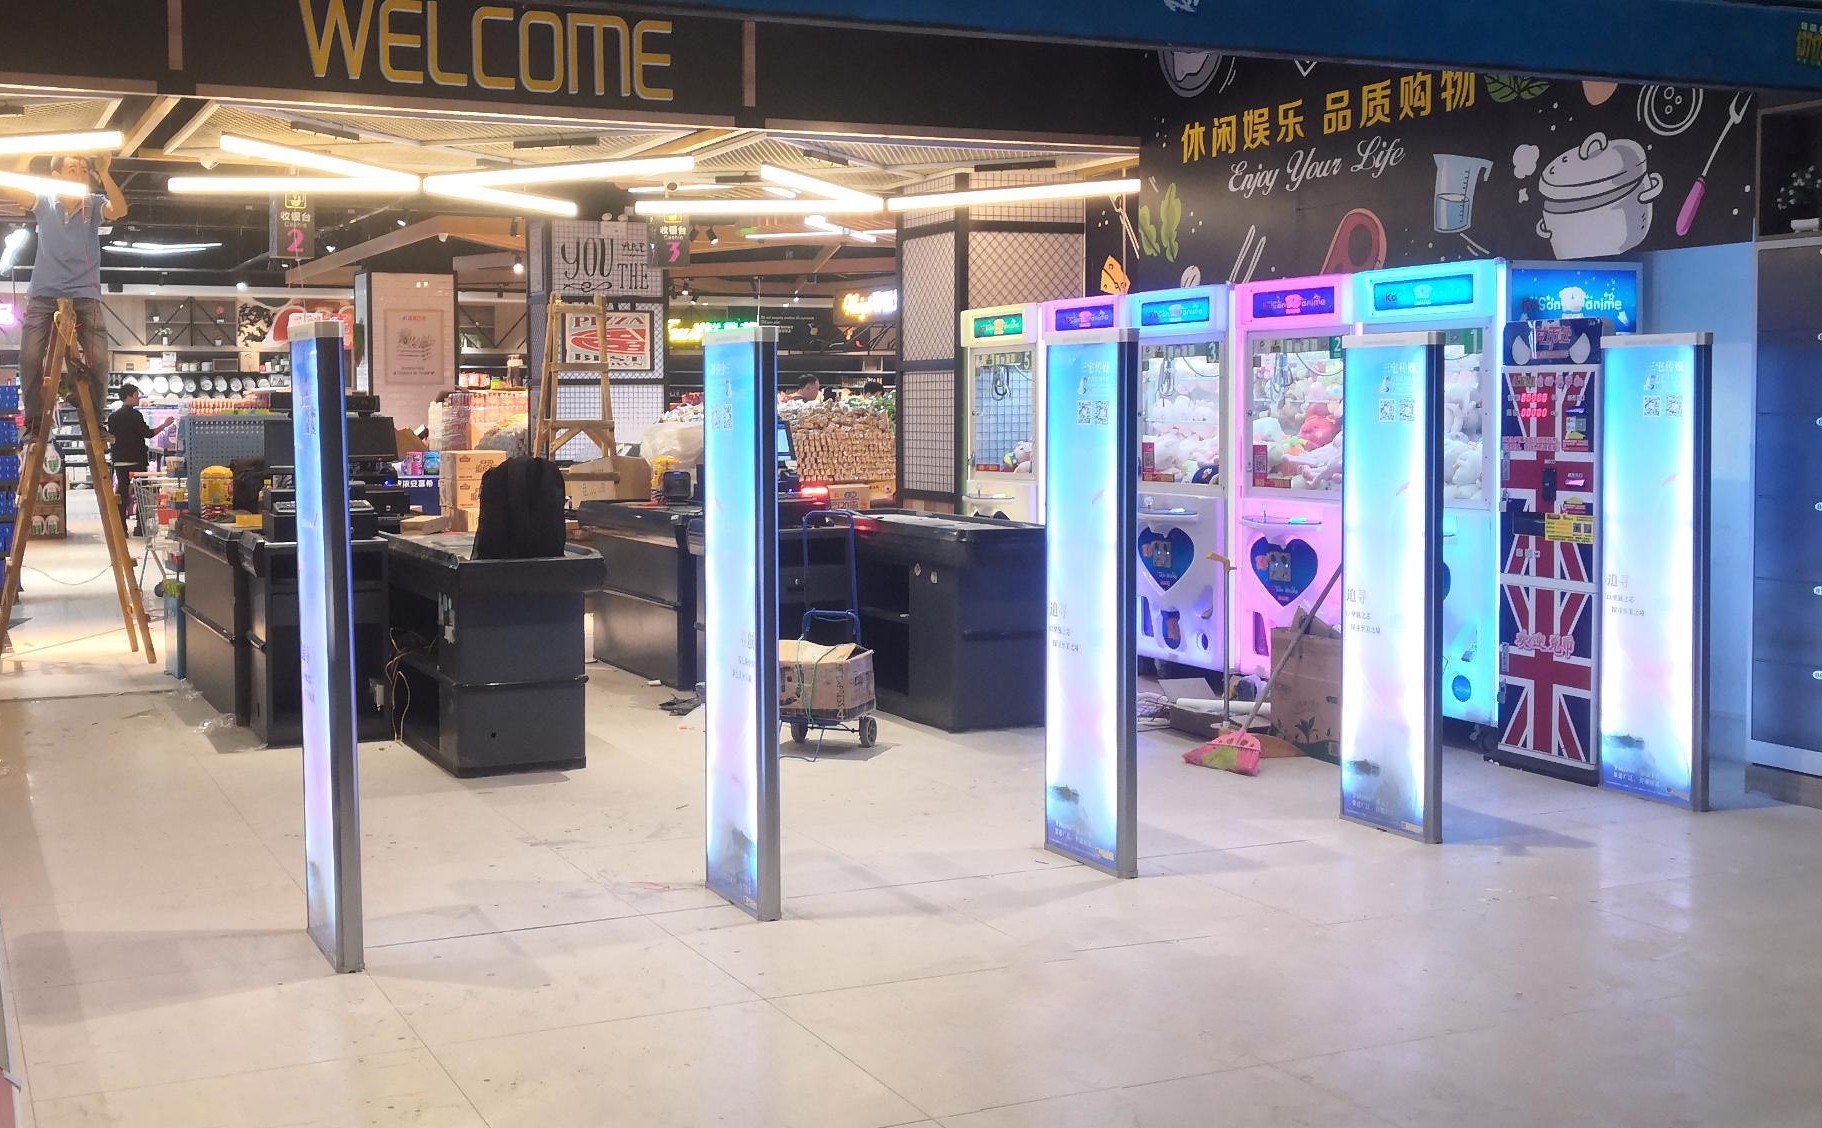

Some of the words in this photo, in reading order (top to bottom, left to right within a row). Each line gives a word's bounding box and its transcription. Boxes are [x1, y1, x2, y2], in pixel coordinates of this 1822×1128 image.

[300, 0, 674, 100] WELCOME
[1181, 99, 1305, 163] 休闲娱乐
[1323, 70, 1476, 135] 品质购物
[1228, 160, 1279, 198] Enjoy
[1286, 148, 1342, 192] Your
[1351, 136, 1405, 178] Life
[280, 211, 311, 222] 收银台
[287, 228, 304, 253] 2
[660, 225, 686, 235] 收银台
[668, 241, 680, 262] 3
[618, 263, 649, 290] THE
[1208, 342, 1216, 363] 3
[1334, 336, 1341, 351] 2
[1024, 351, 1030, 370] 5
